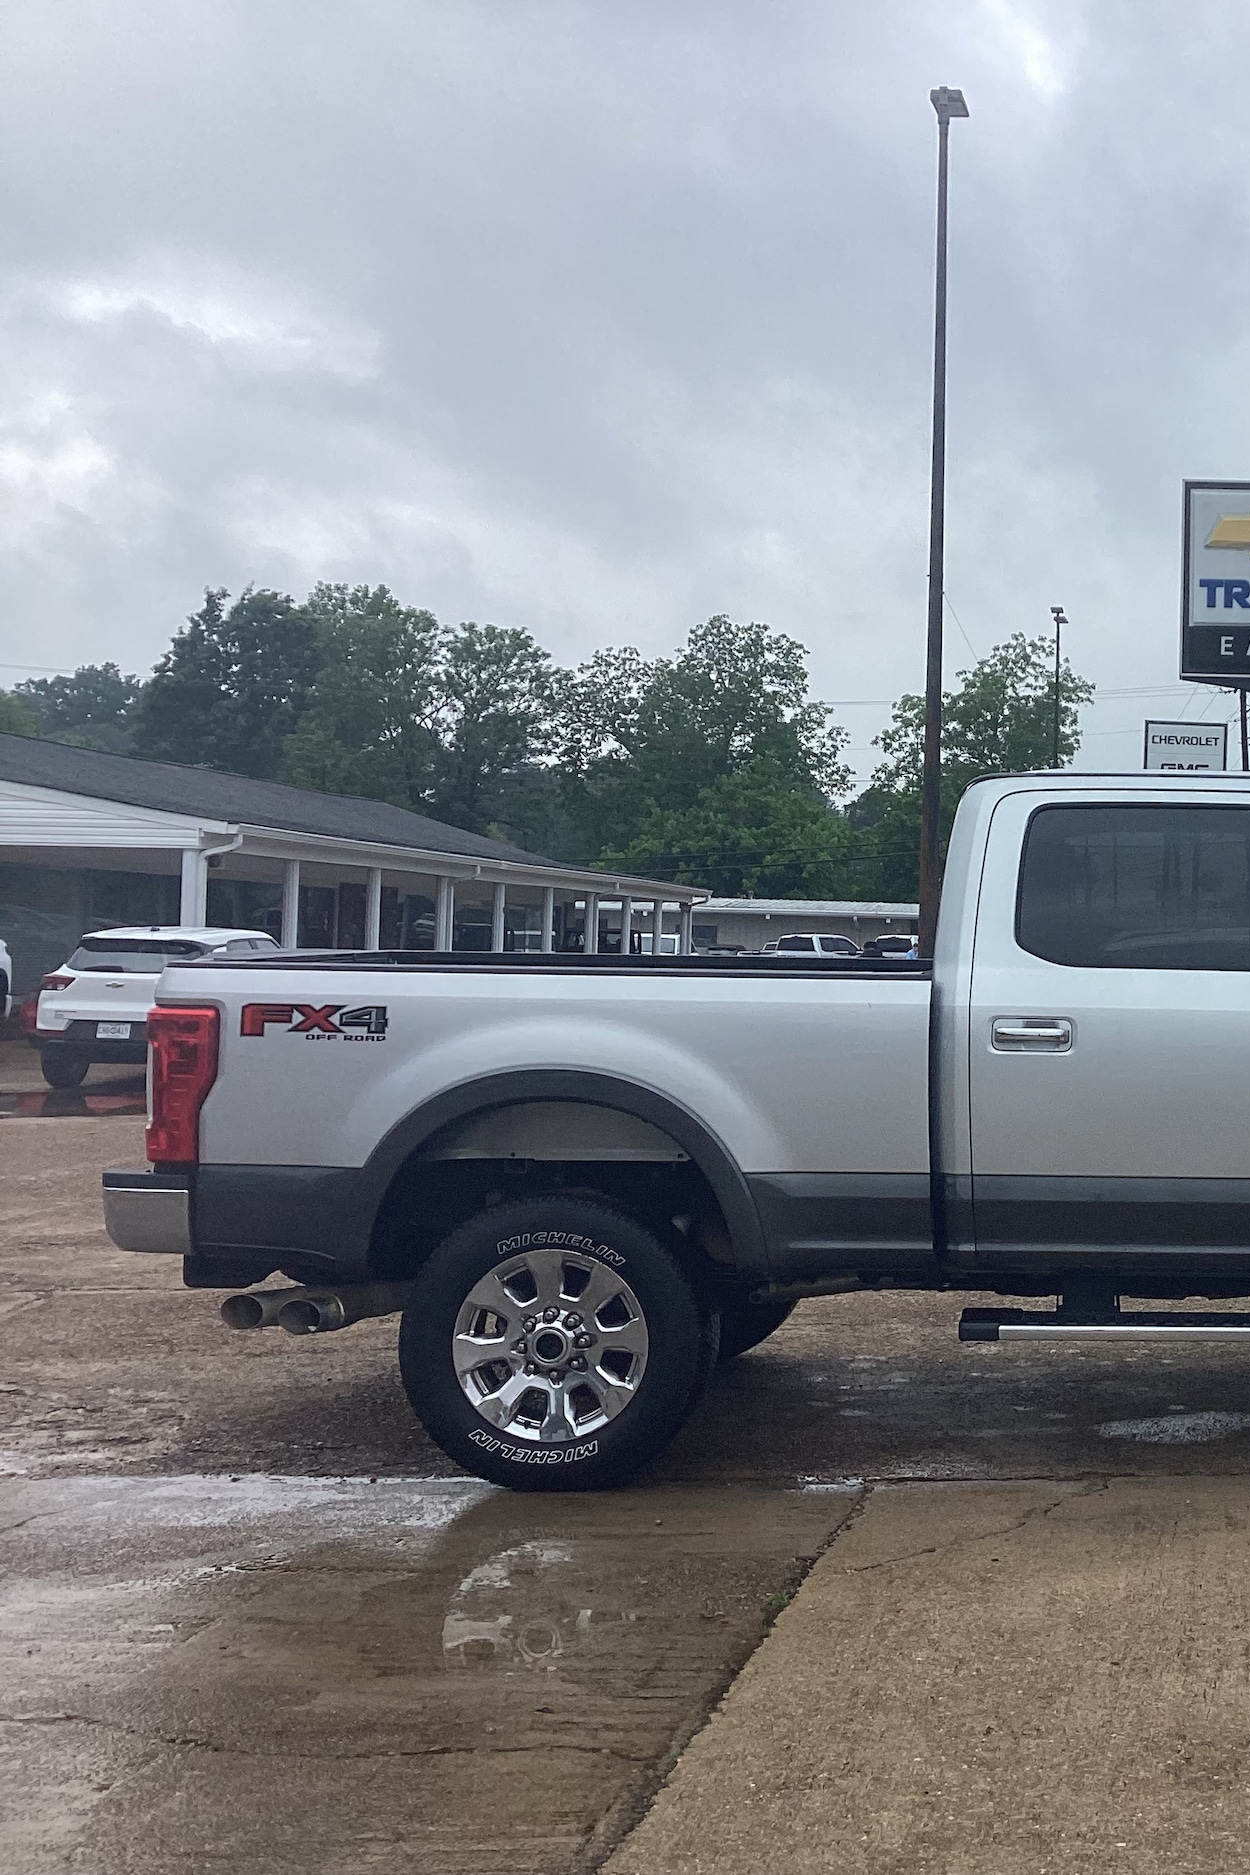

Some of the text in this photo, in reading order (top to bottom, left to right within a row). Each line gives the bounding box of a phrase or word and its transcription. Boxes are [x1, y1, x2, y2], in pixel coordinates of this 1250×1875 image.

[1152, 735, 1219, 746] CHEVROLET
[240, 1003, 389, 1037] FX4
[497, 1232, 626, 1267] MICHELIN
[468, 1429, 598, 1464] MICHELIN
